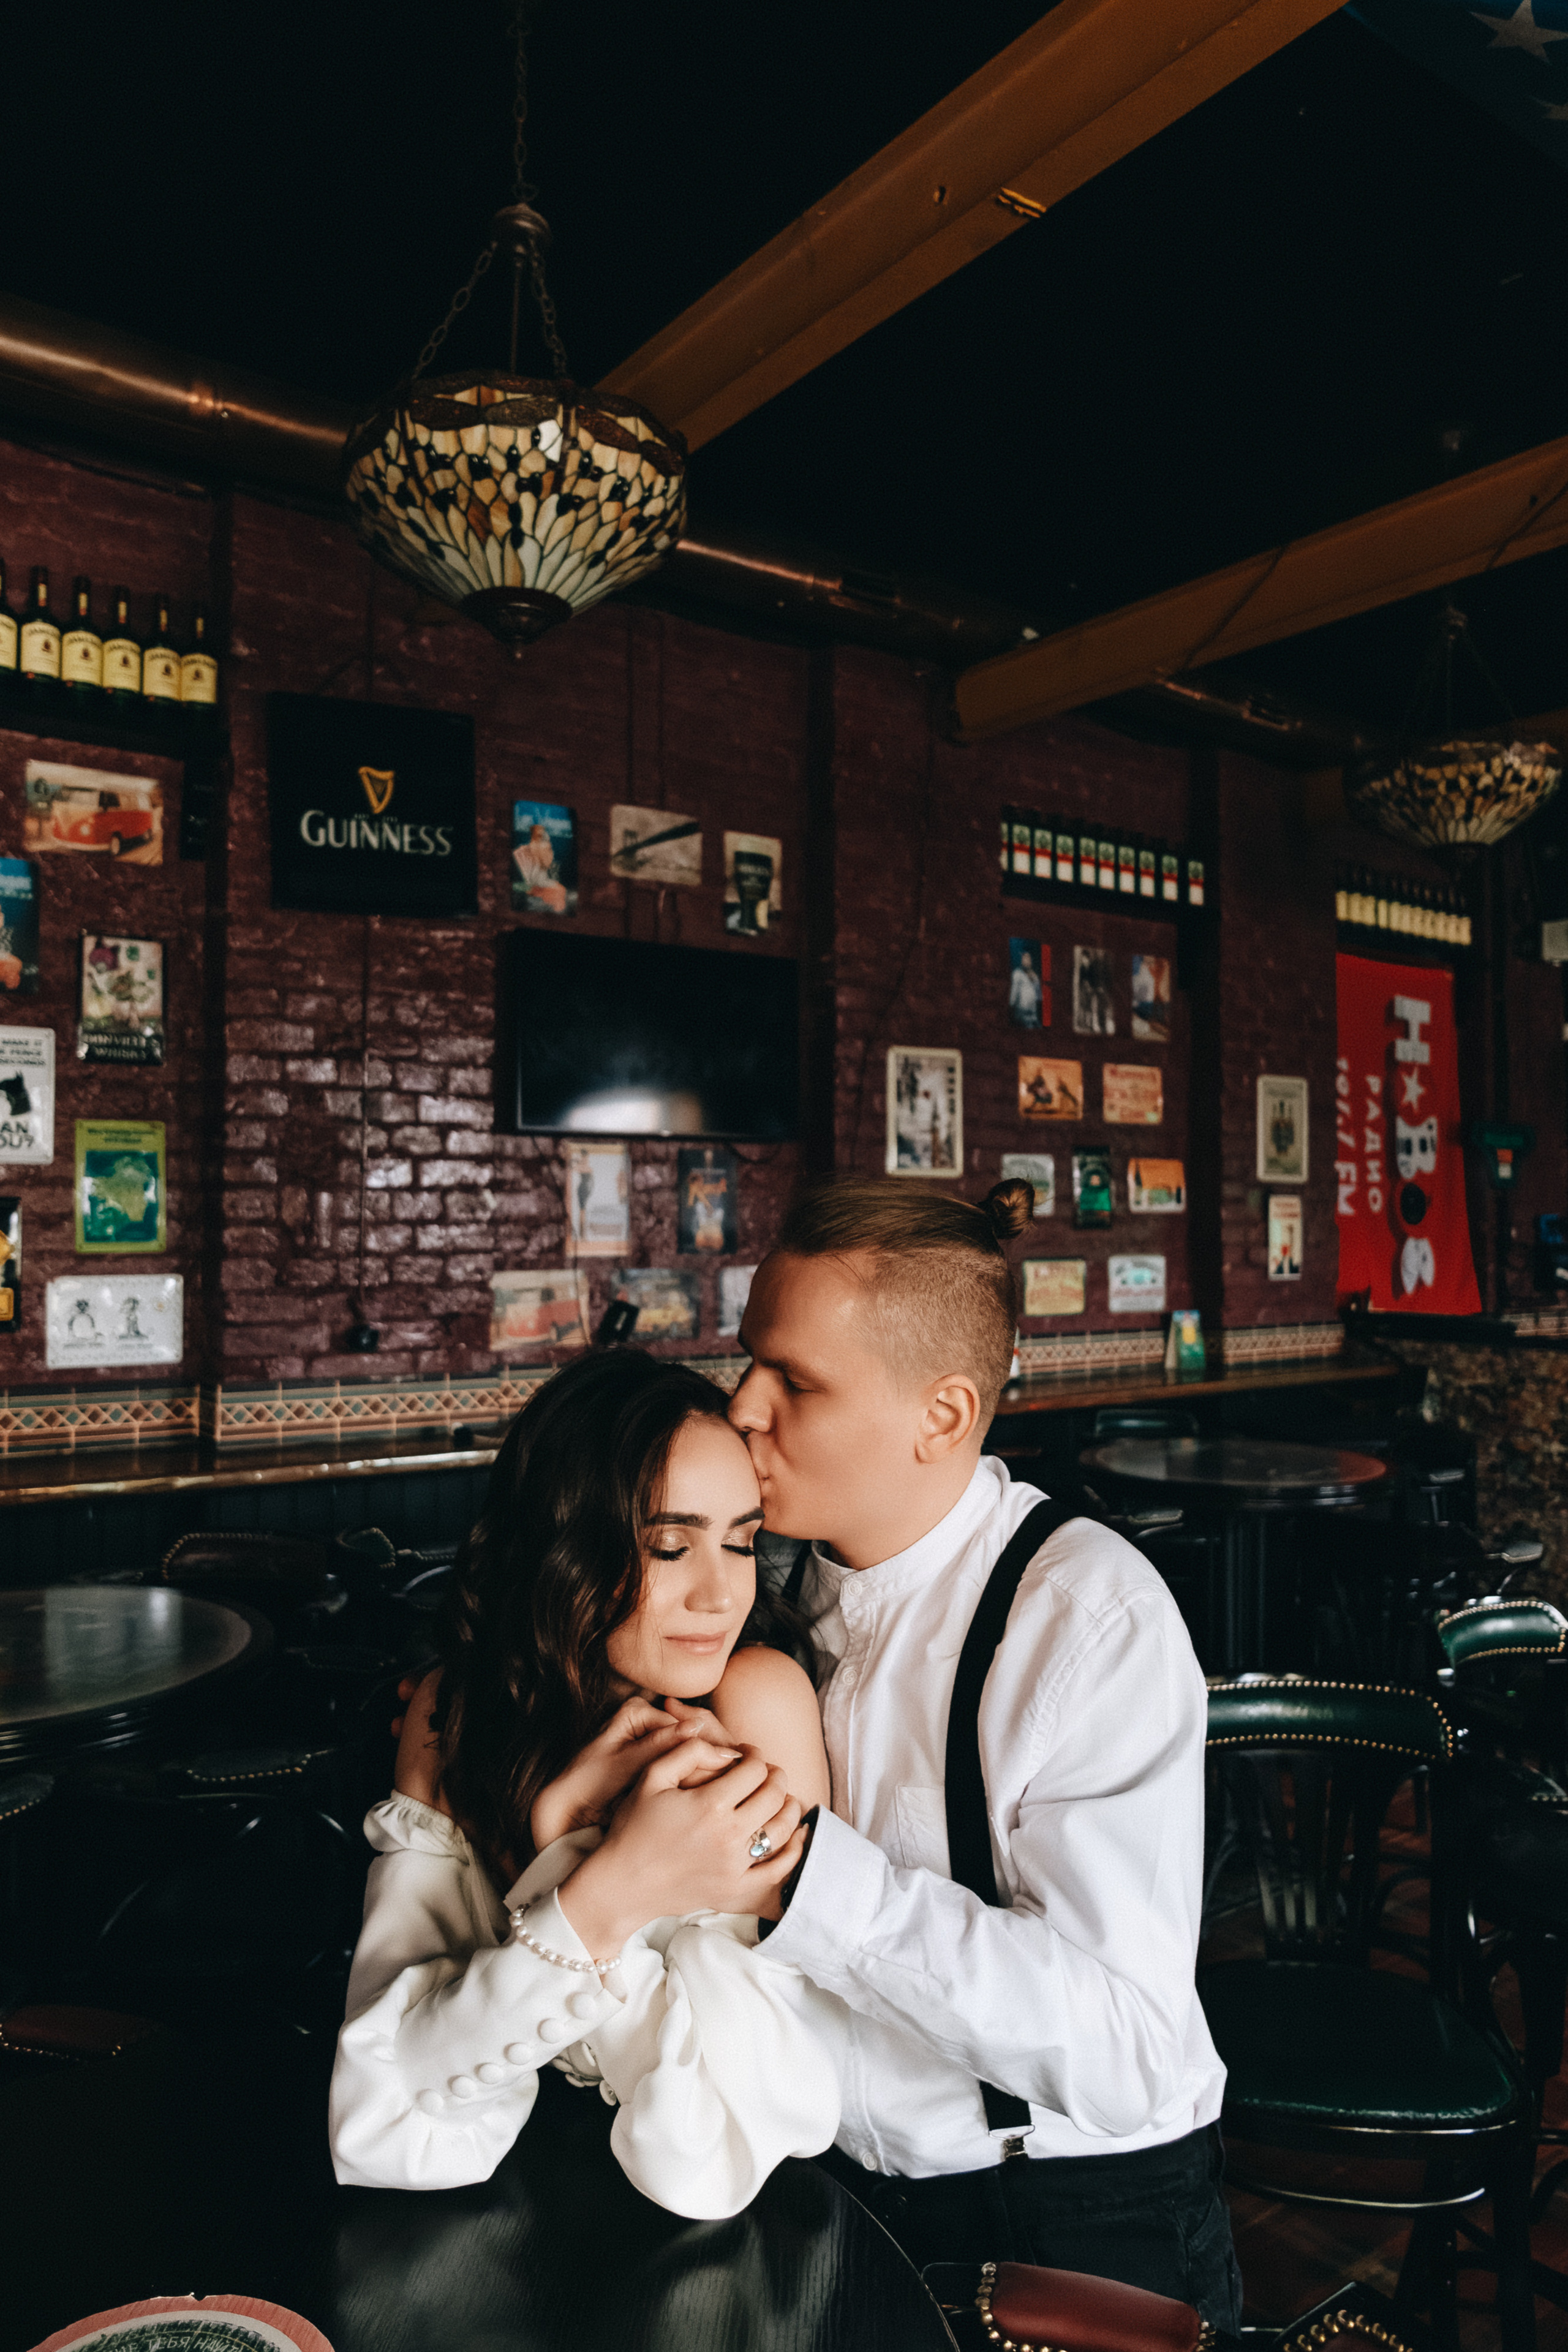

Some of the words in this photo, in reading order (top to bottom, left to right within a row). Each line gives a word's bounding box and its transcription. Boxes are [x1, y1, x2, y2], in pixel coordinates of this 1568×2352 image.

[300, 810, 453, 856] GUINNESS
[0, 1120, 29, 1133] AN
[0, 1133, 34, 1148] OU?
[1364, 1073, 1383, 1214] РАДИО
[1335, 1160, 1356, 1216] FM
[147, 2336, 190, 2351] ТЕБЯ
